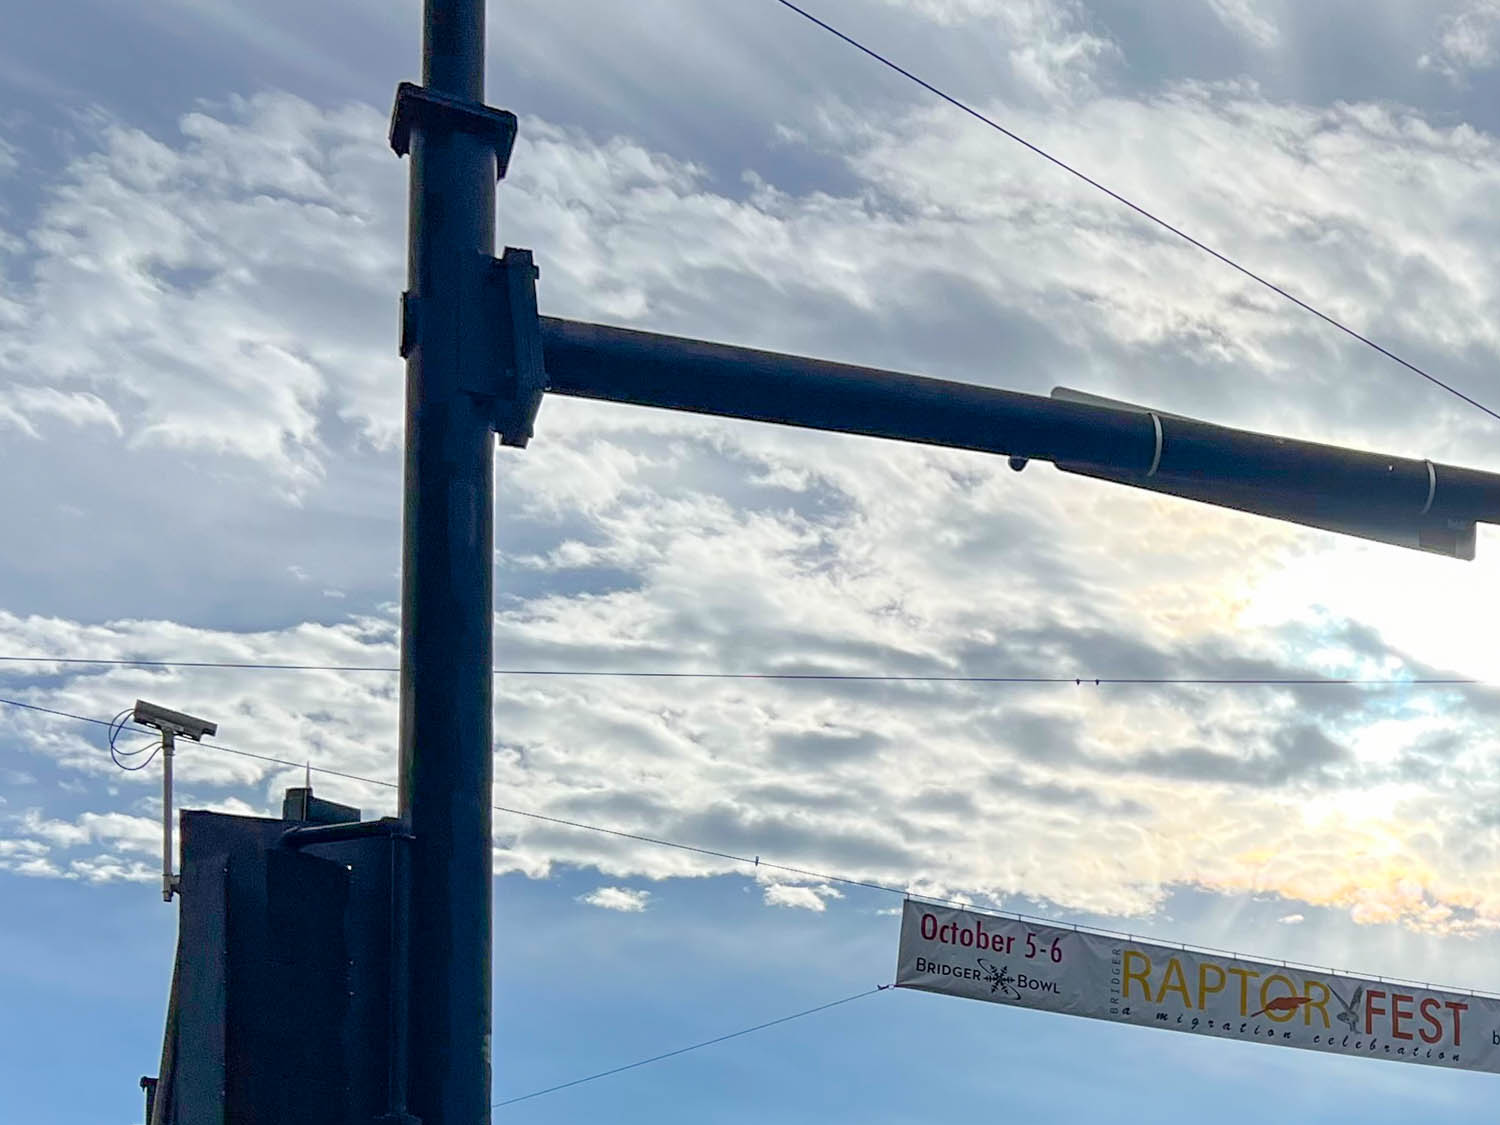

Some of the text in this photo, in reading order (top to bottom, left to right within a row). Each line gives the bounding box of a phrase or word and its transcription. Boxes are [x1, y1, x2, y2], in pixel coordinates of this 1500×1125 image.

[920, 913, 1063, 964] October 5-6
[916, 957, 1061, 994] BRIDGER BOWL
[1110, 948, 1121, 1015] BRIDGER
[1121, 950, 1469, 1047] RAPTOR FEST
[1122, 1006, 1461, 1062] a migration celebration
